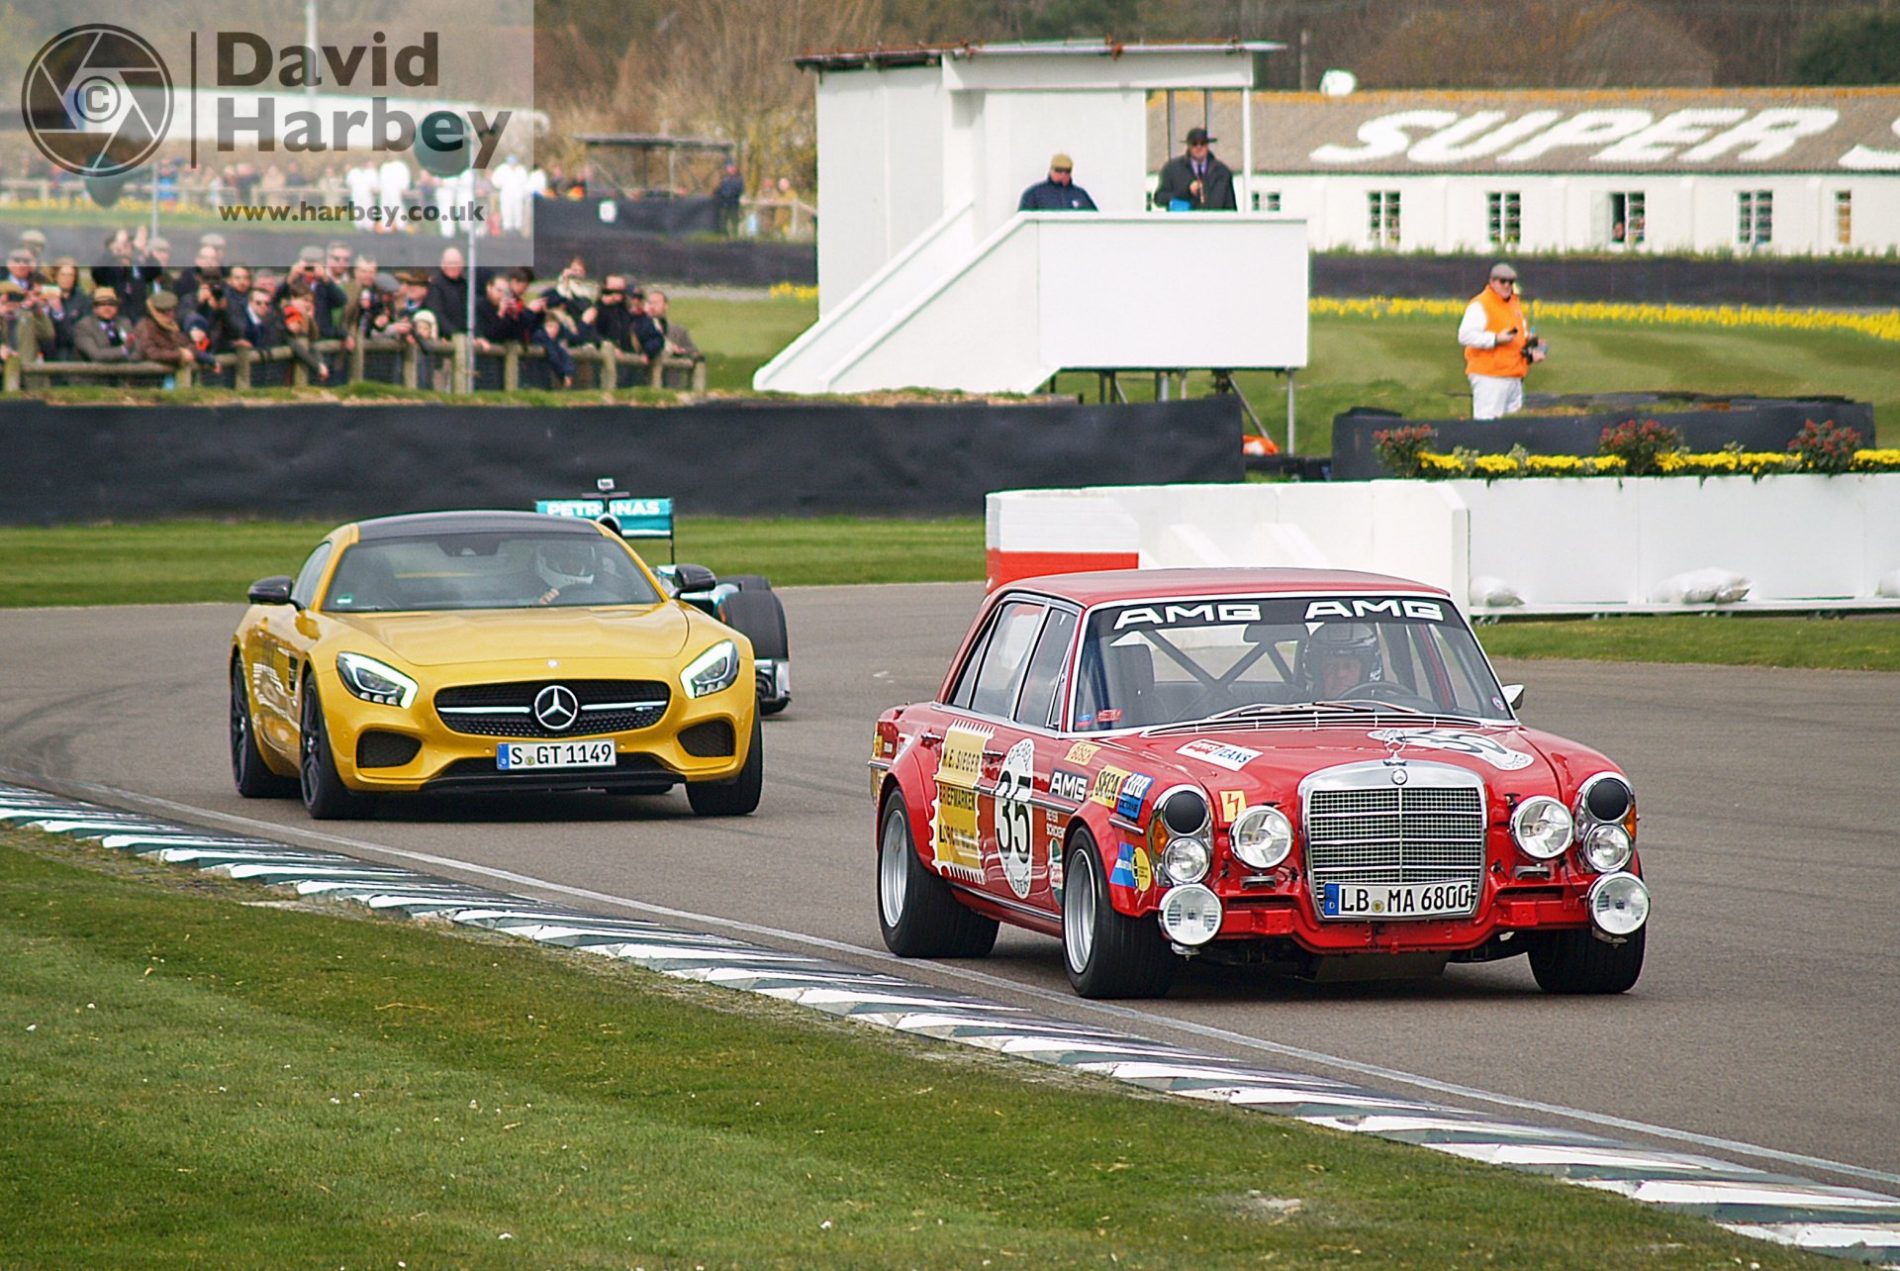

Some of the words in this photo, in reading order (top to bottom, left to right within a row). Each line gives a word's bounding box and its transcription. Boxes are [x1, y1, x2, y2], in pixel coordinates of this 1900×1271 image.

[1309, 108, 1839, 165] SUPER
[1113, 604, 1261, 630] AMG
[1305, 599, 1444, 623] AMG
[511, 746, 523, 766] S
[536, 745, 562, 765] GT
[566, 743, 612, 764] 1149
[1050, 772, 1087, 801] AMG
[996, 769, 1032, 864] 35
[1341, 888, 1369, 912] LB
[1388, 889, 1415, 913] MA
[1421, 884, 1470, 911] 6800
